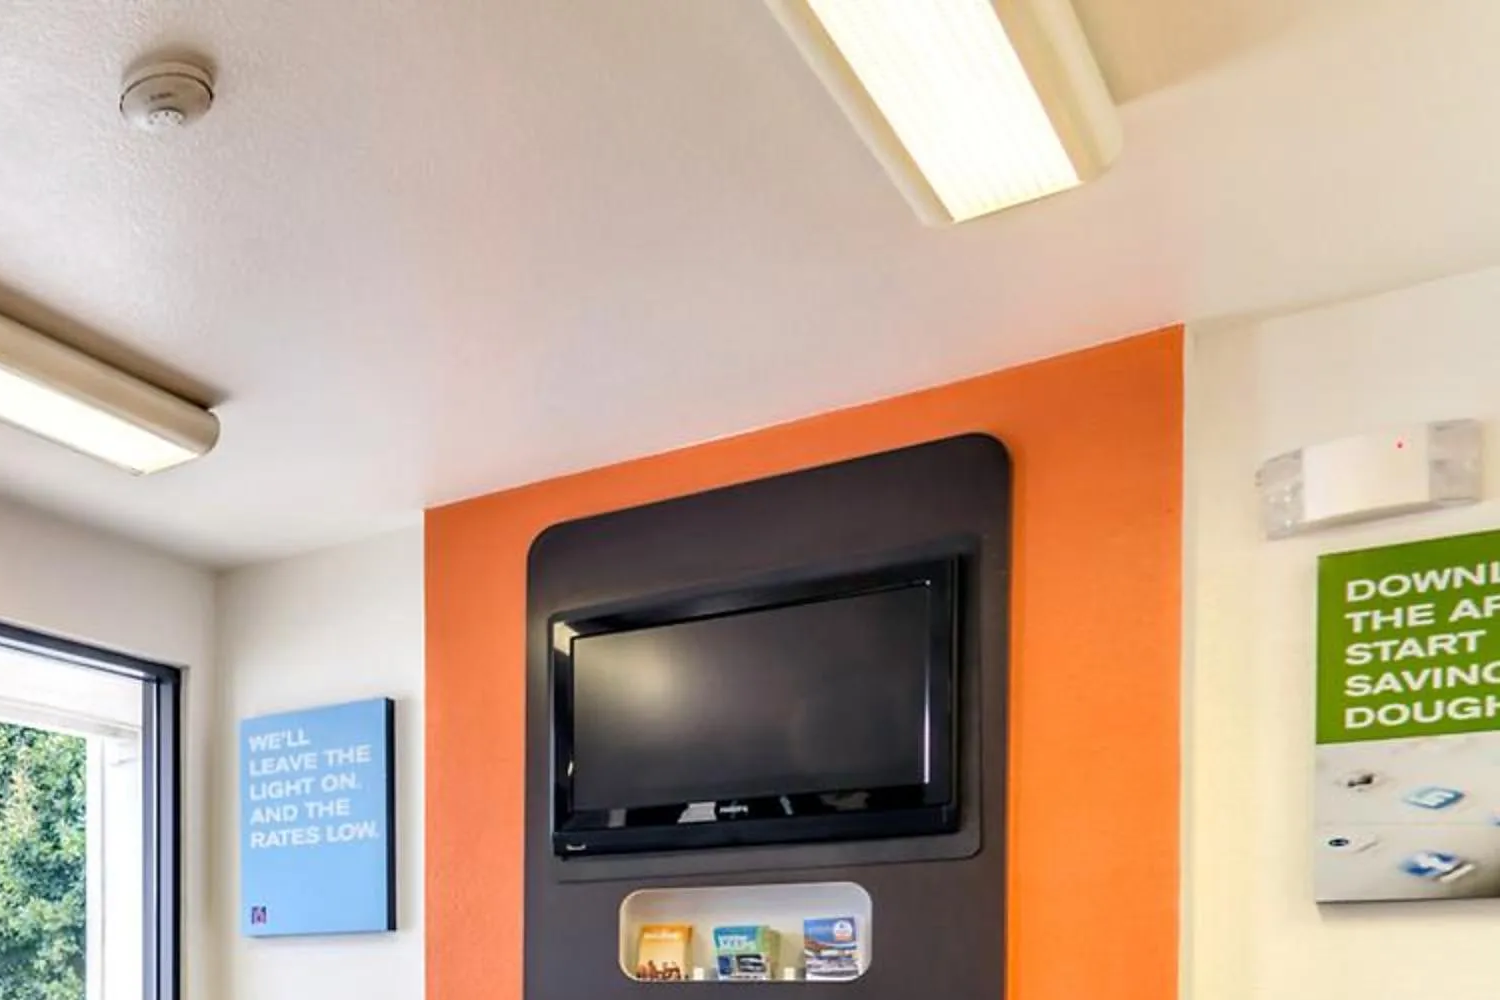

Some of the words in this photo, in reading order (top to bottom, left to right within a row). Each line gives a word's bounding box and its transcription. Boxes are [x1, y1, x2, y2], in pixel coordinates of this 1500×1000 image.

[1344, 603, 1435, 633] THE
[1345, 629, 1487, 666] START
[249, 728, 311, 752] WE'LL
[250, 752, 318, 776] LEAVE
[322, 744, 372, 769] THE
[250, 777, 316, 801] LIGHT
[250, 804, 298, 826] AND
[305, 798, 351, 819] THE
[250, 826, 320, 849] RATES
